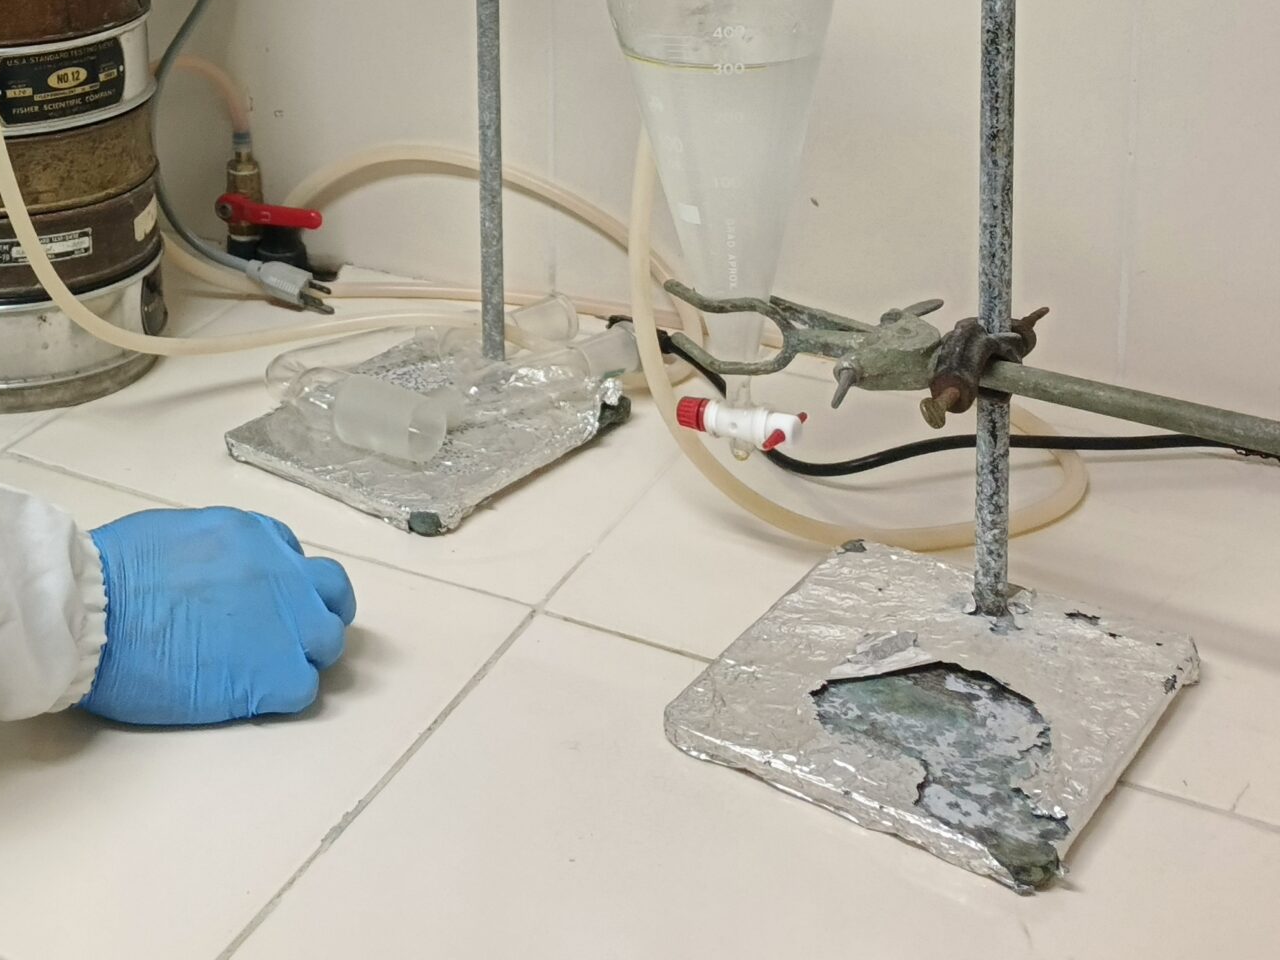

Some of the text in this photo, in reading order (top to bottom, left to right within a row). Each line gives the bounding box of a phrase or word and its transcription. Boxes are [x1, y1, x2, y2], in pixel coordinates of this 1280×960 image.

[712, 25, 746, 39] 400
[29, 52, 69, 64] STANDARD
[713, 62, 746, 76] 300
[12, 105, 40, 115] FISHER
[43, 97, 83, 111] SCIENTIFIC
